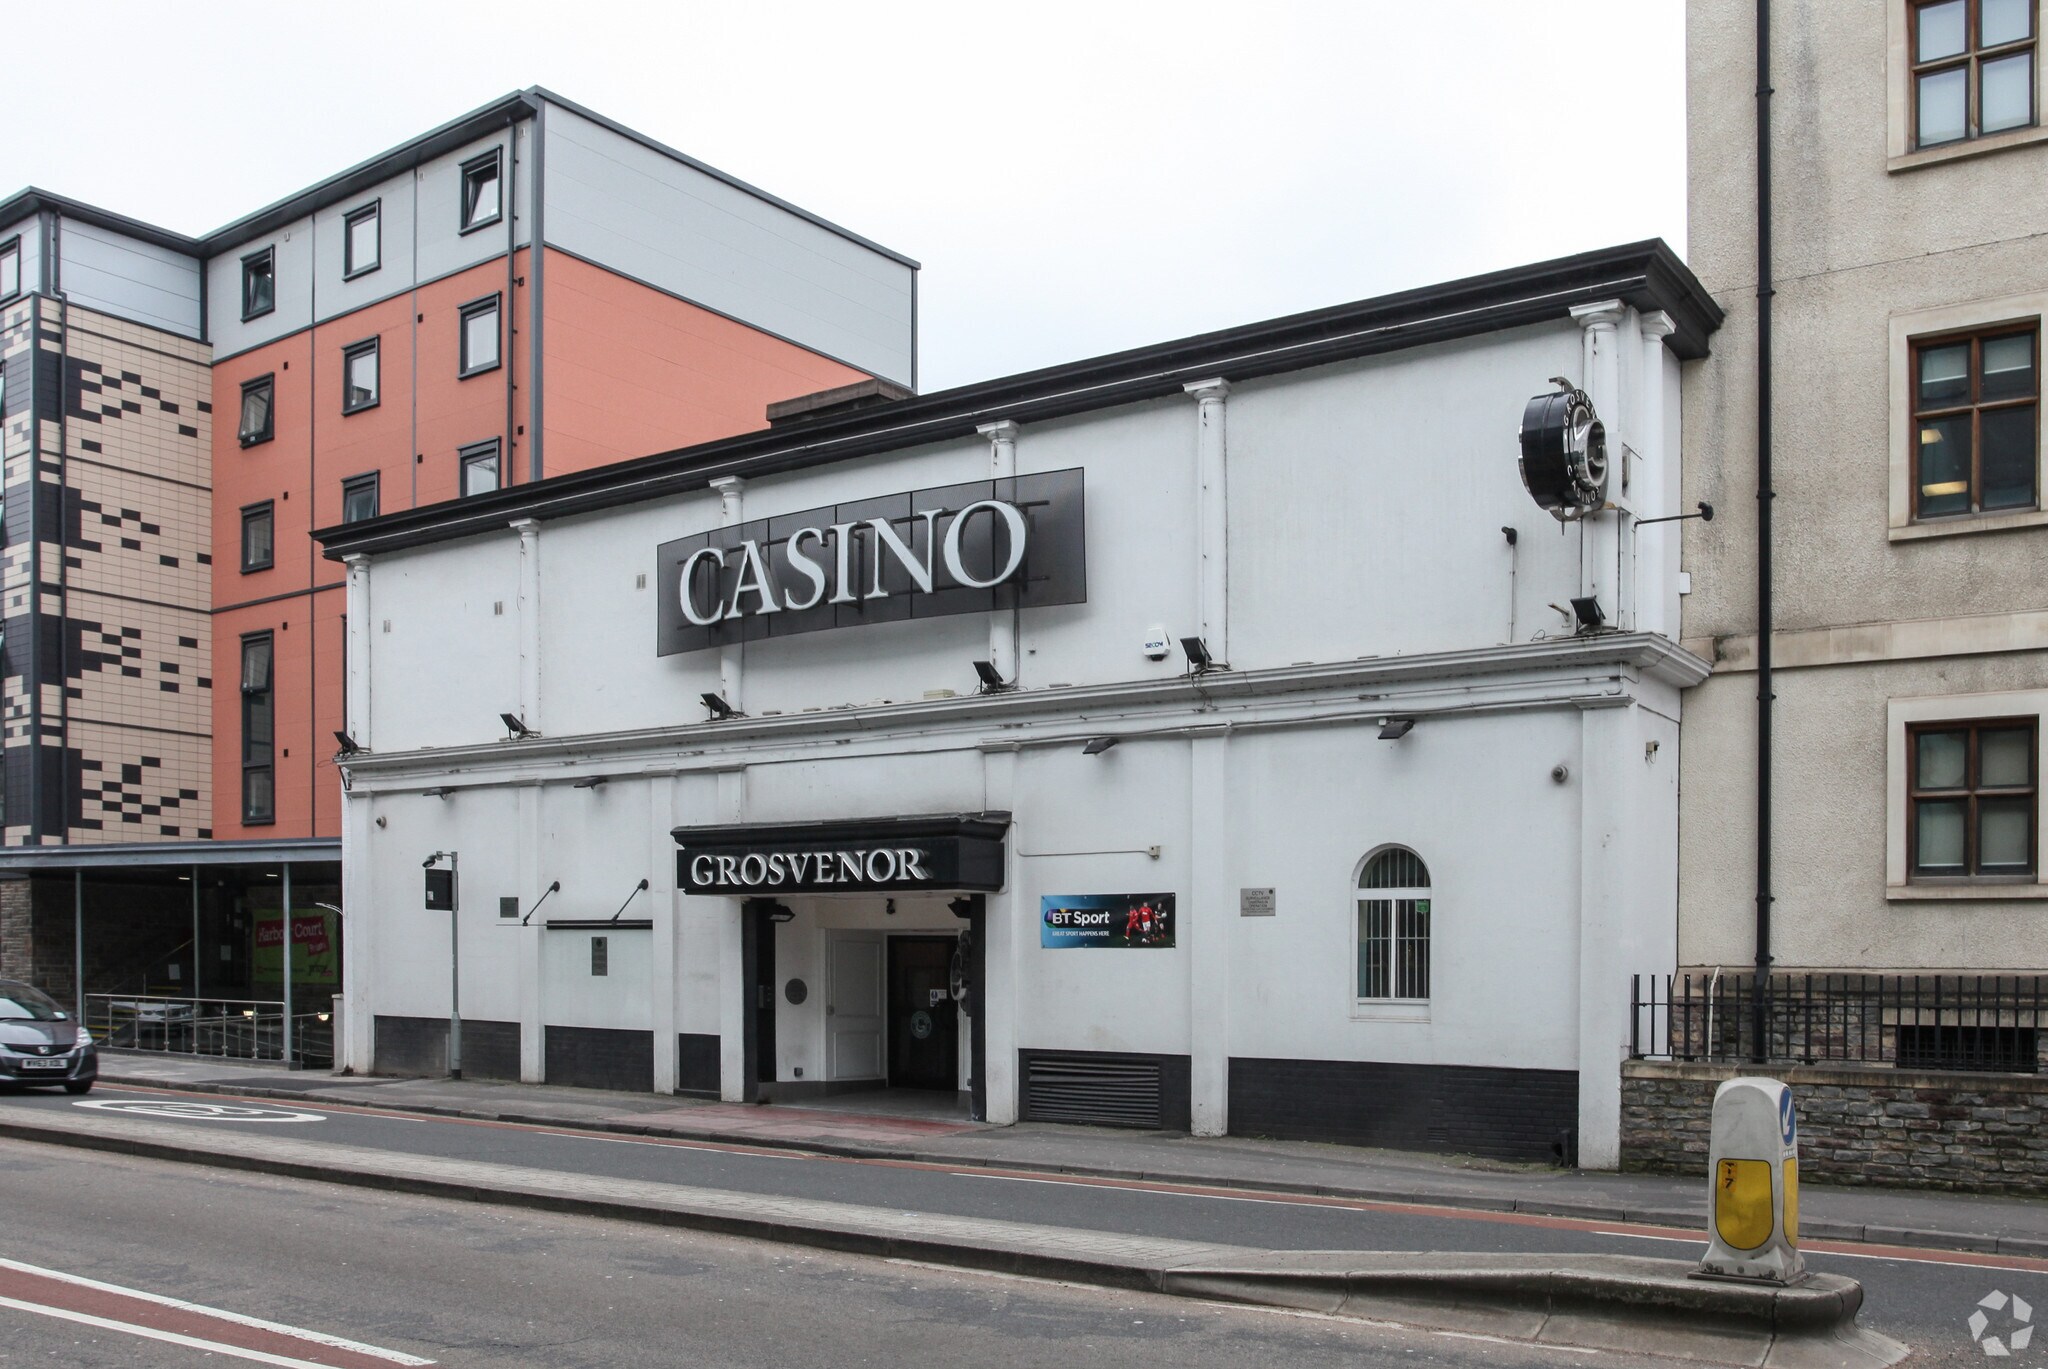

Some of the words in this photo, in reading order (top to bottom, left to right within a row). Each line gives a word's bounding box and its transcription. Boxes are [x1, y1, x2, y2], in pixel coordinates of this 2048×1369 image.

[679, 498, 1029, 627] CASINO
[690, 848, 930, 886] GROSVENOR
[294, 922, 324, 938] Court
[1052, 912, 1072, 924] BT
[1073, 911, 1110, 926] Sport
